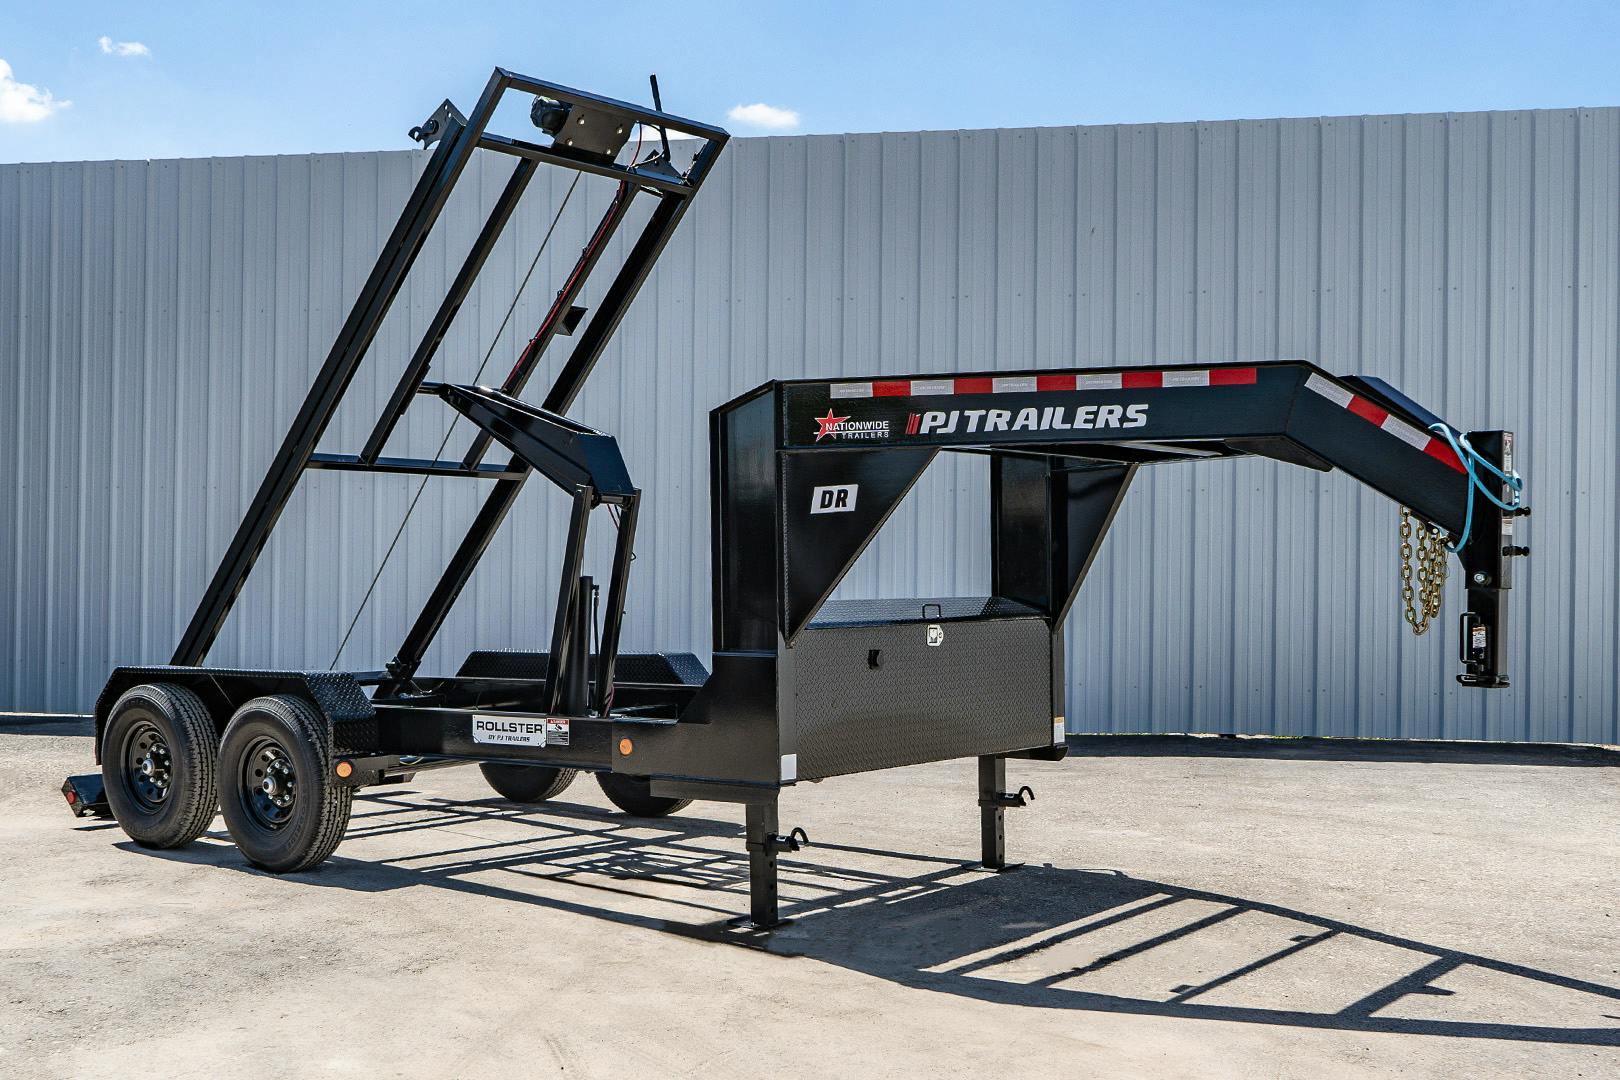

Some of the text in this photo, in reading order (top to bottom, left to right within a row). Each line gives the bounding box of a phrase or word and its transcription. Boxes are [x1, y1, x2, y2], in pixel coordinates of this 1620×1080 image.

[825, 421, 889, 431] NATIONWIDE
[841, 431, 889, 439] TRAILERS
[820, 489, 848, 508] DR
[476, 721, 543, 734] ROLLSTER
